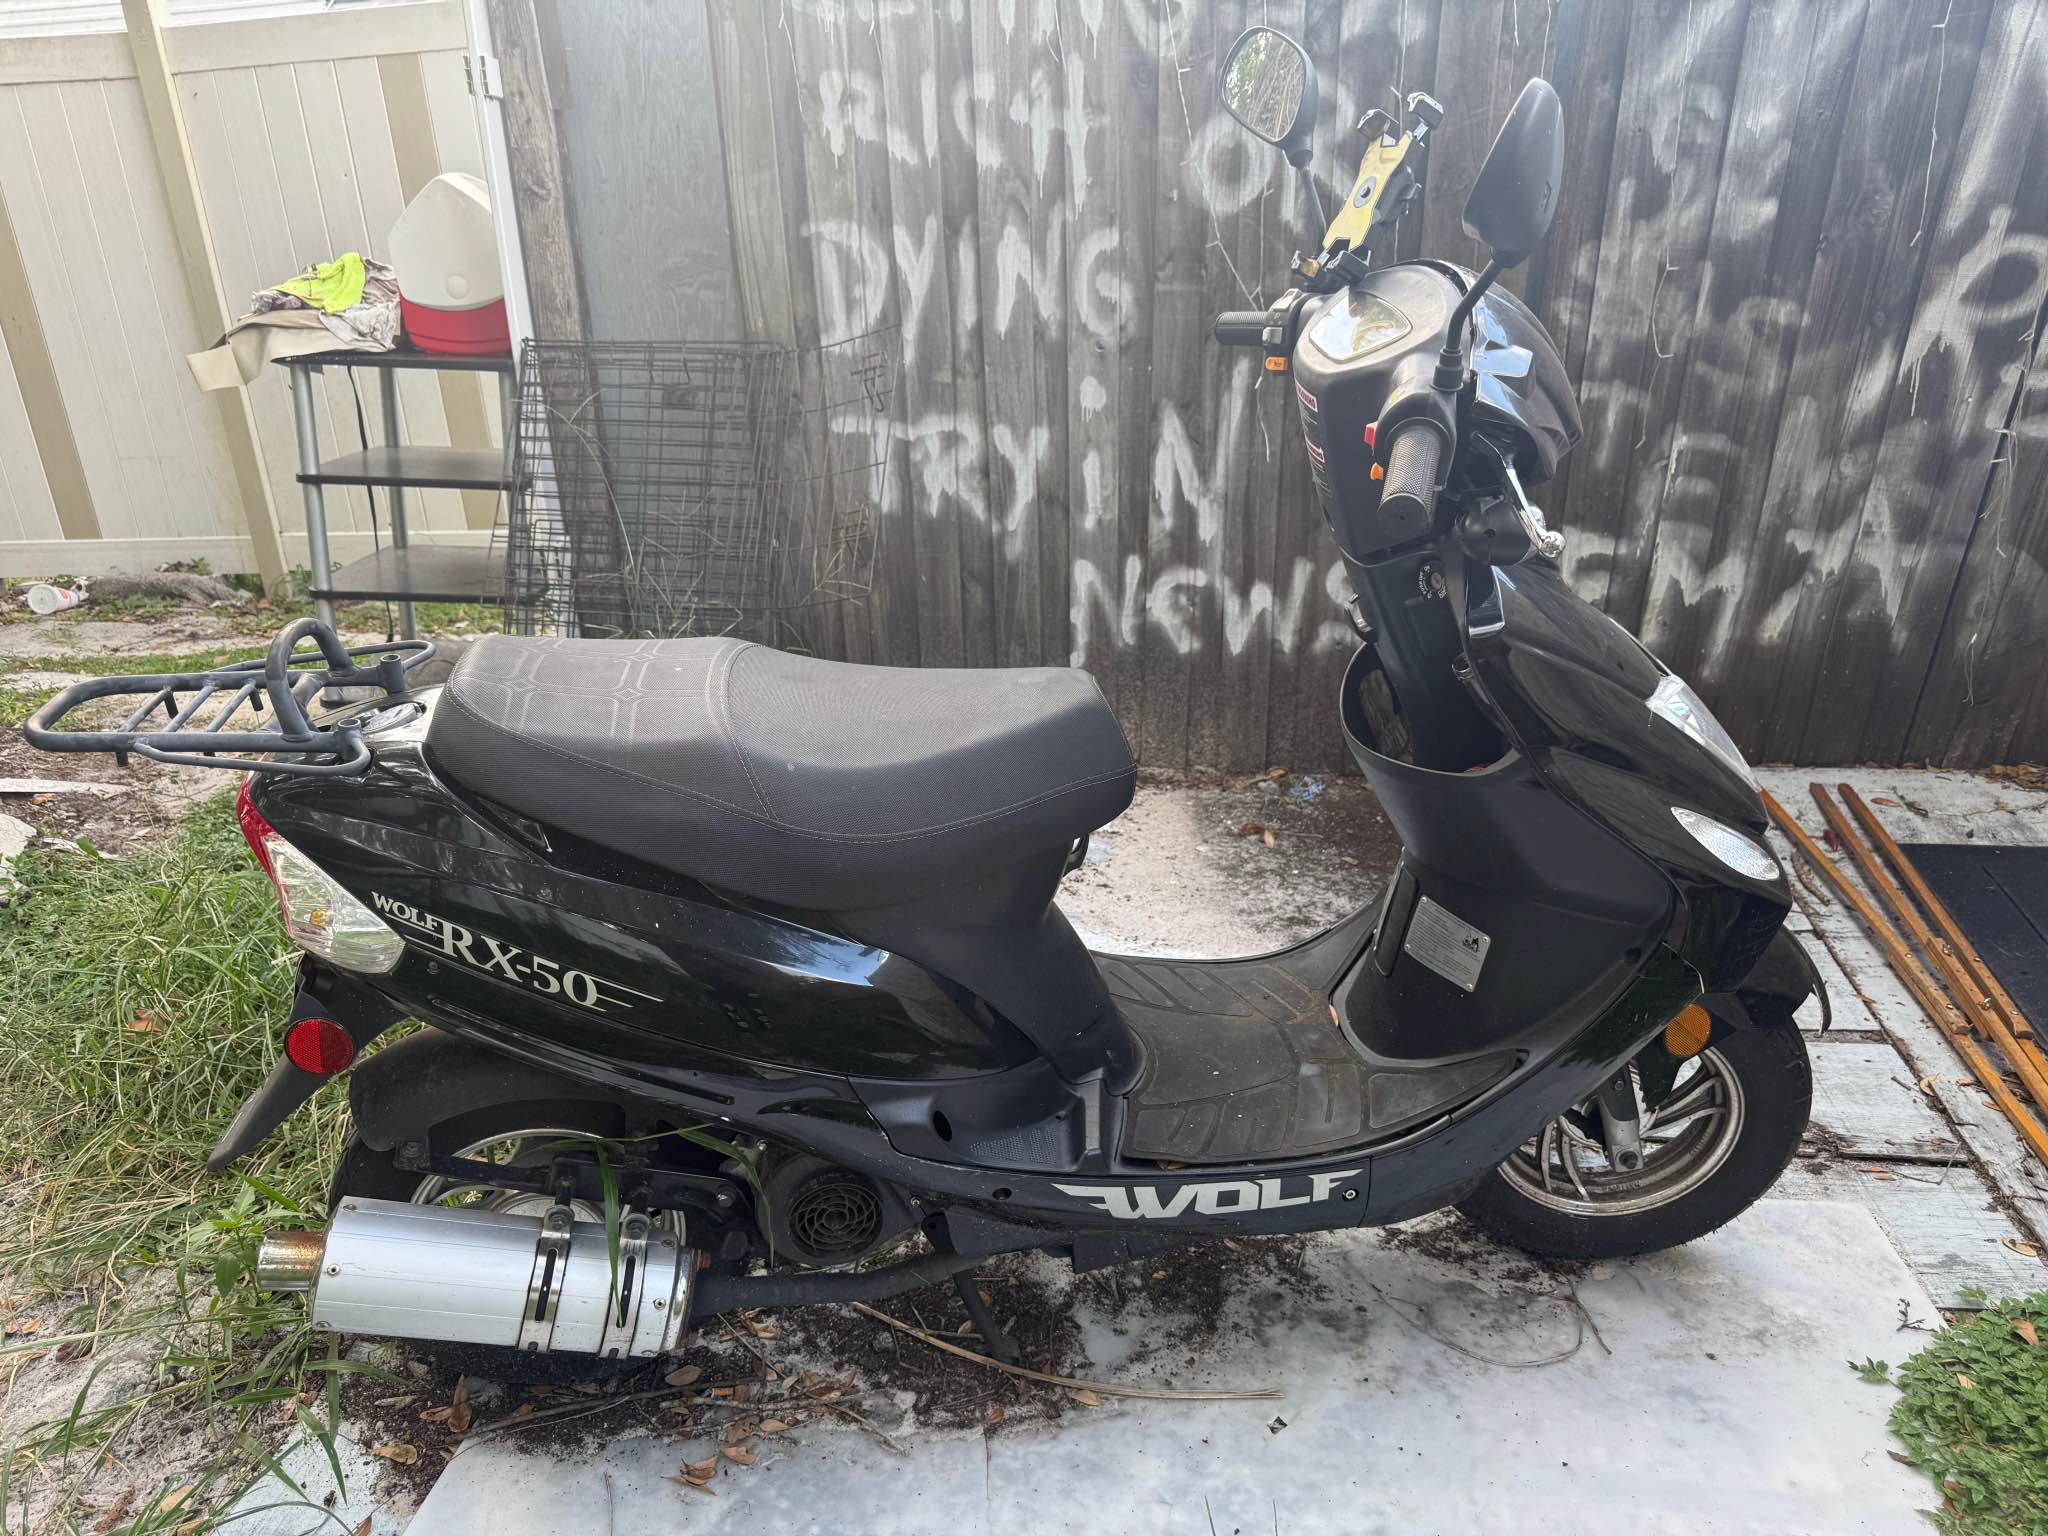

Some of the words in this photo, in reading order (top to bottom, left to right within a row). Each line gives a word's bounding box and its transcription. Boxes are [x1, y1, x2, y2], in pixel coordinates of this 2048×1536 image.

[801, 213, 1137, 362] DYING
[371, 891, 438, 930] WOLF
[442, 920, 606, 1011] RX-50
[1051, 1169, 1364, 1219] WOLF
